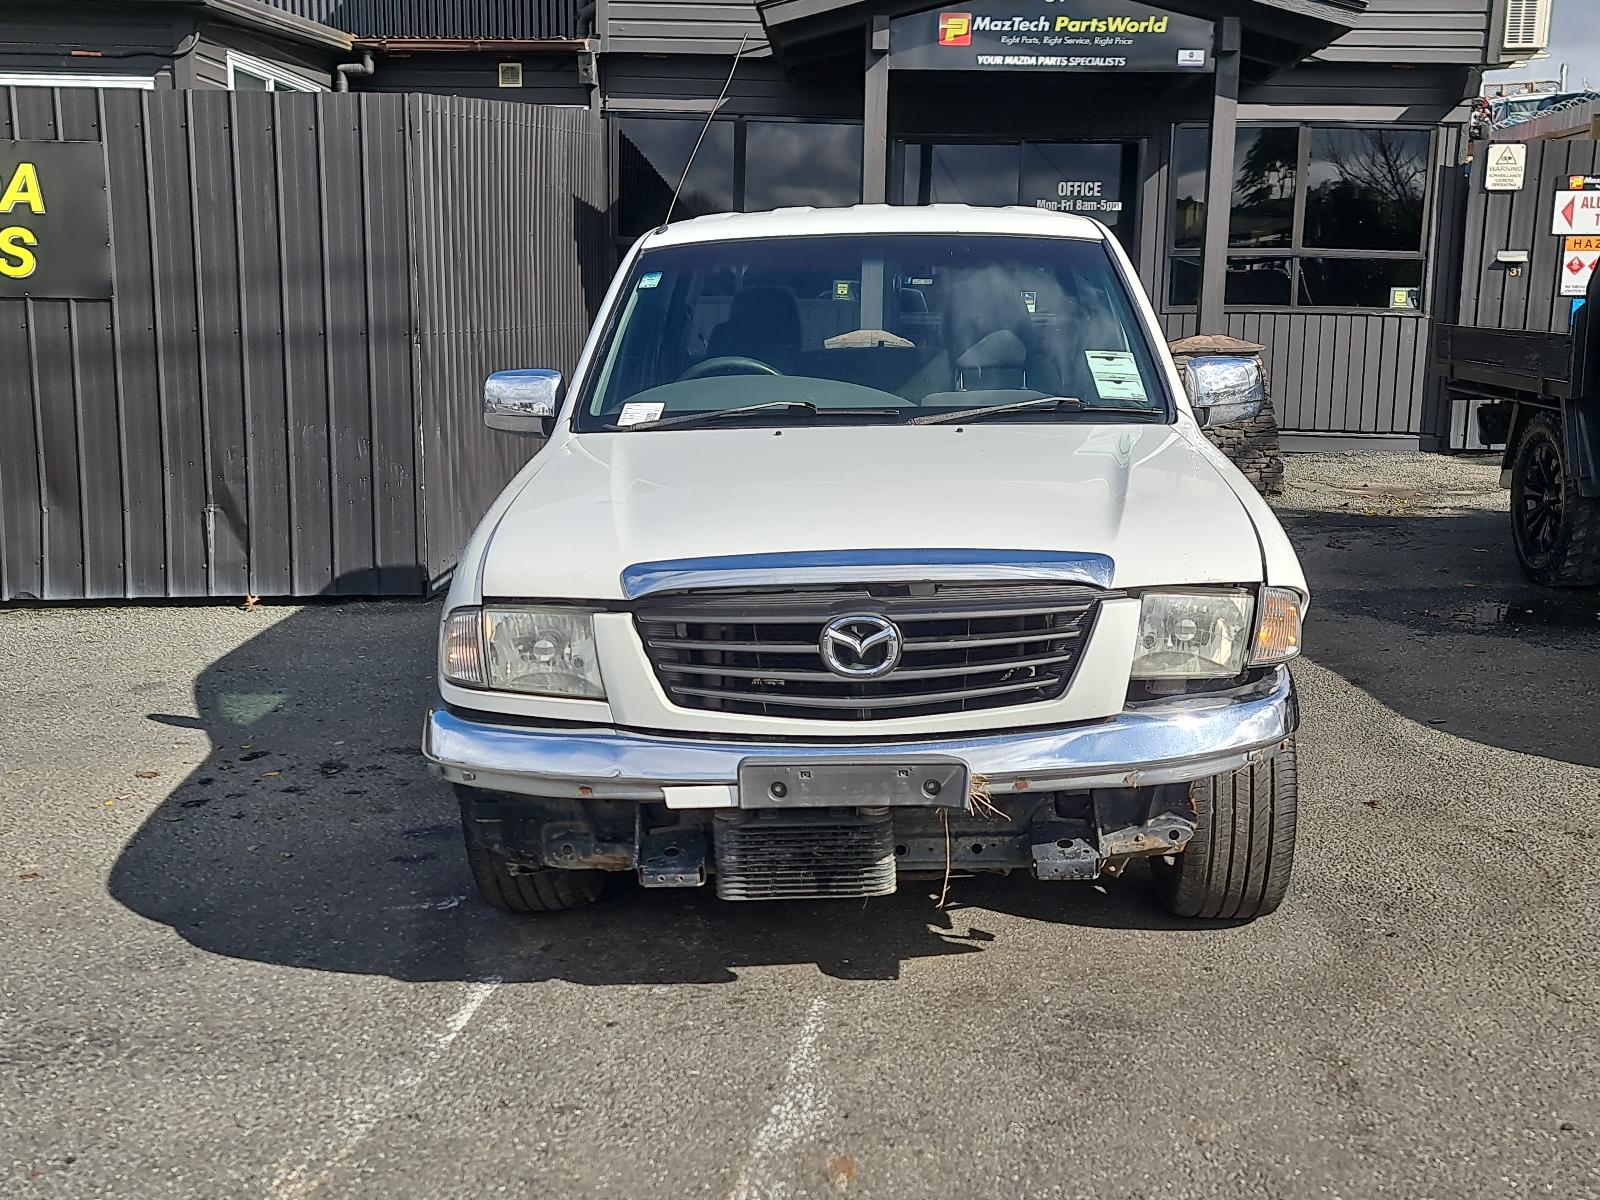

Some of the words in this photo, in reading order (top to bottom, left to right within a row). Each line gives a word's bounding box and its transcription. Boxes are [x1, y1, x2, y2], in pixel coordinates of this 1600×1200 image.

[972, 16, 1050, 31] MazTech
[1055, 16, 1169, 33] PartsWorld
[1001, 35, 1020, 45] Right
[1021, 36, 1041, 45] Parts,
[1043, 36, 1061, 46] Right
[1063, 36, 1092, 46] Service,
[1094, 36, 1113, 47] Right
[1114, 37, 1134, 45] Price
[977, 56, 1004, 65] YOUR
[1004, 56, 1036, 65] MAZDA
[1038, 56, 1068, 66] PARTS
[1068, 57, 1127, 66] SPECIALISTS
[1057, 181, 1102, 197] OFFICE
[1036, 199, 1073, 210] Mon-Fri
[1076, 199, 1122, 211] 8am-5pm
[1510, 267, 1521, 277] 31
